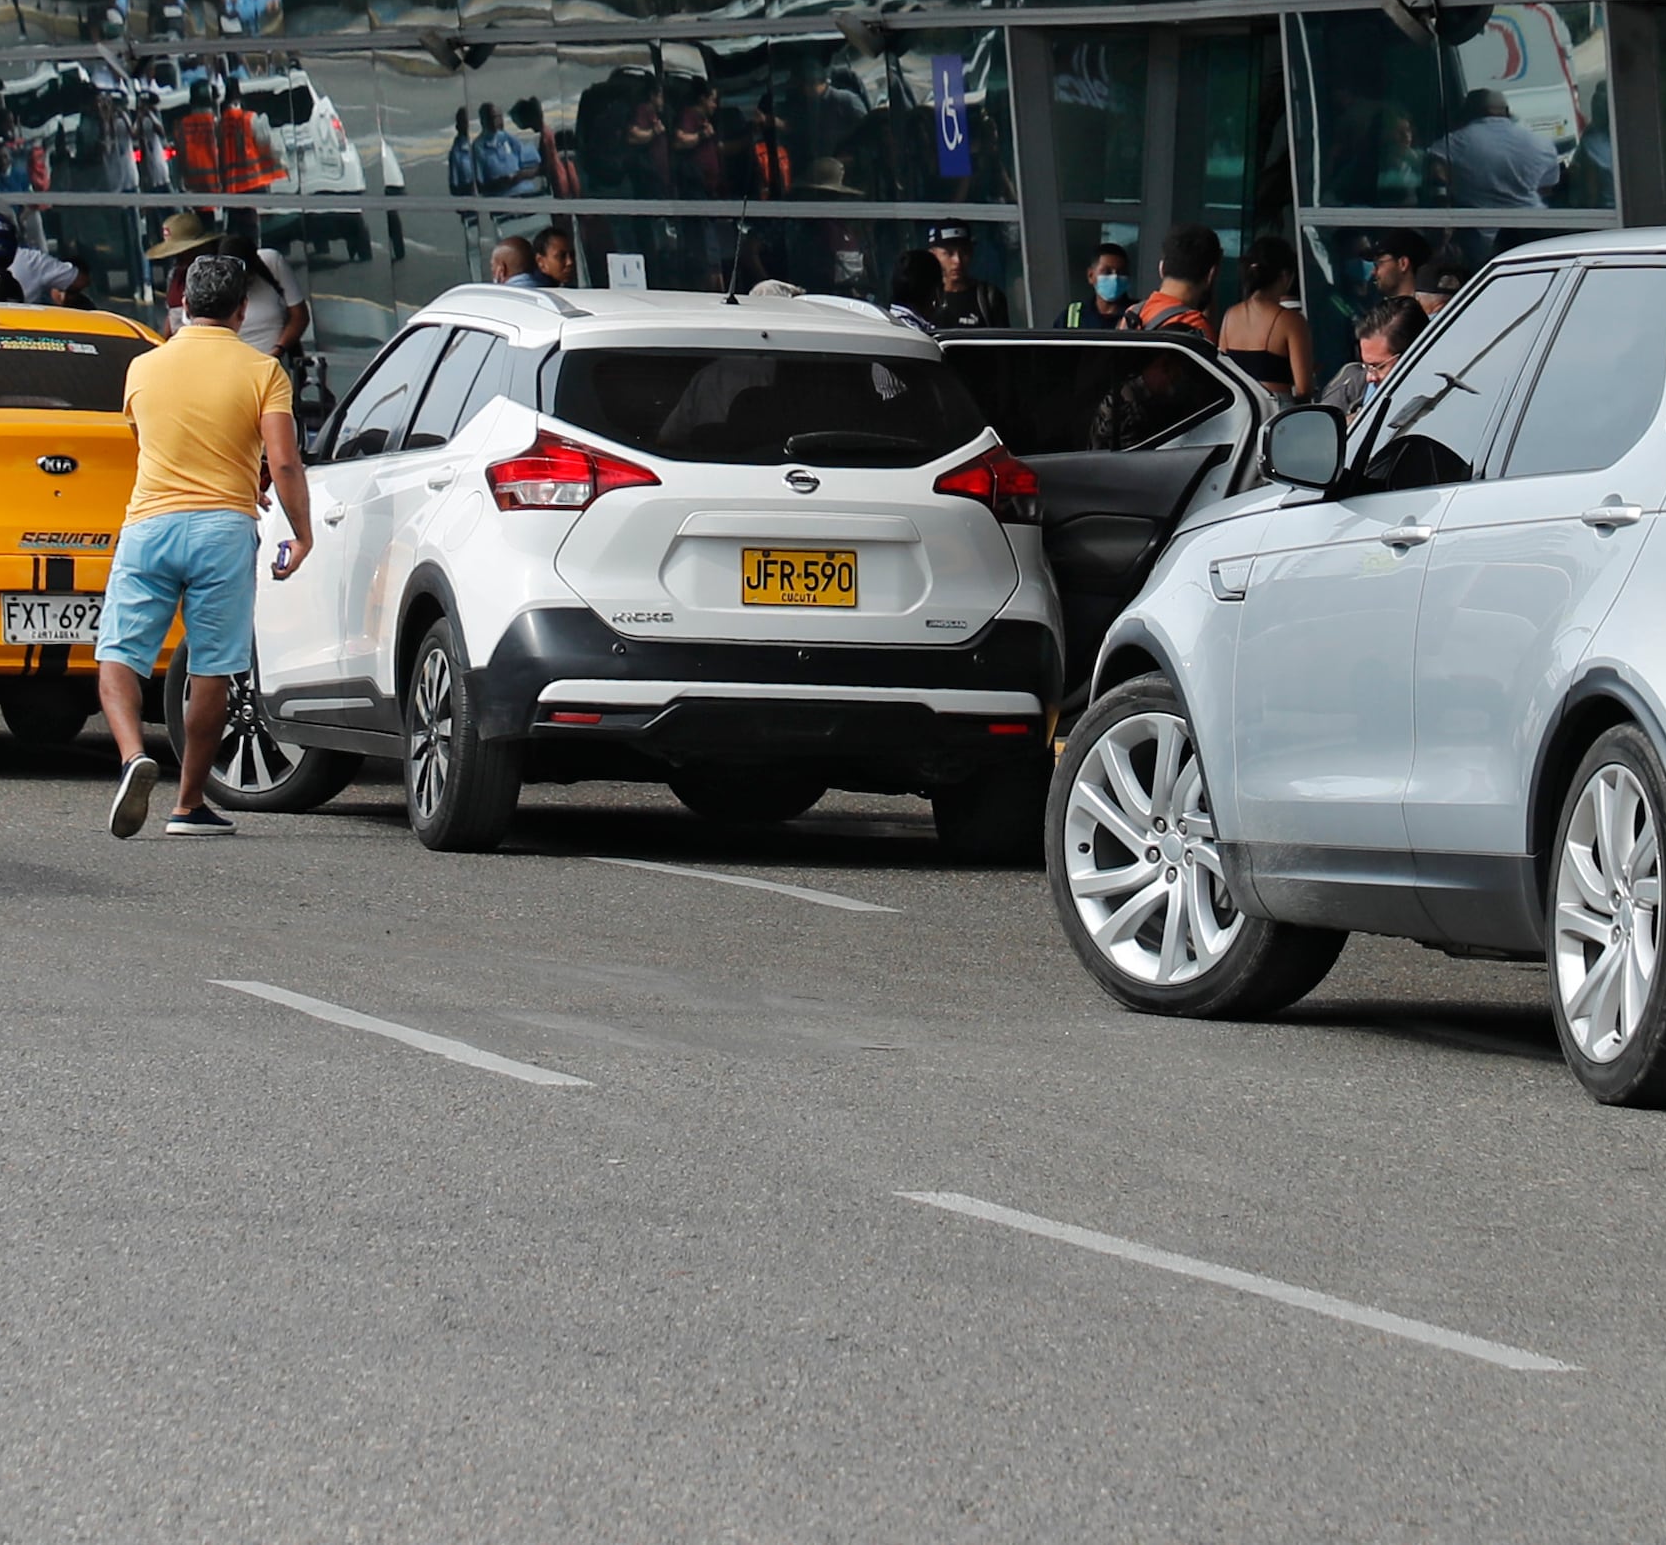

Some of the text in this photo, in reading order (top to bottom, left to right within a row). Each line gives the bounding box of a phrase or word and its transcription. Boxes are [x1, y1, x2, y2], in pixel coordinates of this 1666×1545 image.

[44, 458, 73, 471] KIA
[19, 532, 112, 549] SERVICIO
[746, 559, 853, 592] JFR 590
[781, 593, 818, 603] CUCUTA
[6, 602, 50, 629] FXT
[612, 612, 674, 623] KICKS
